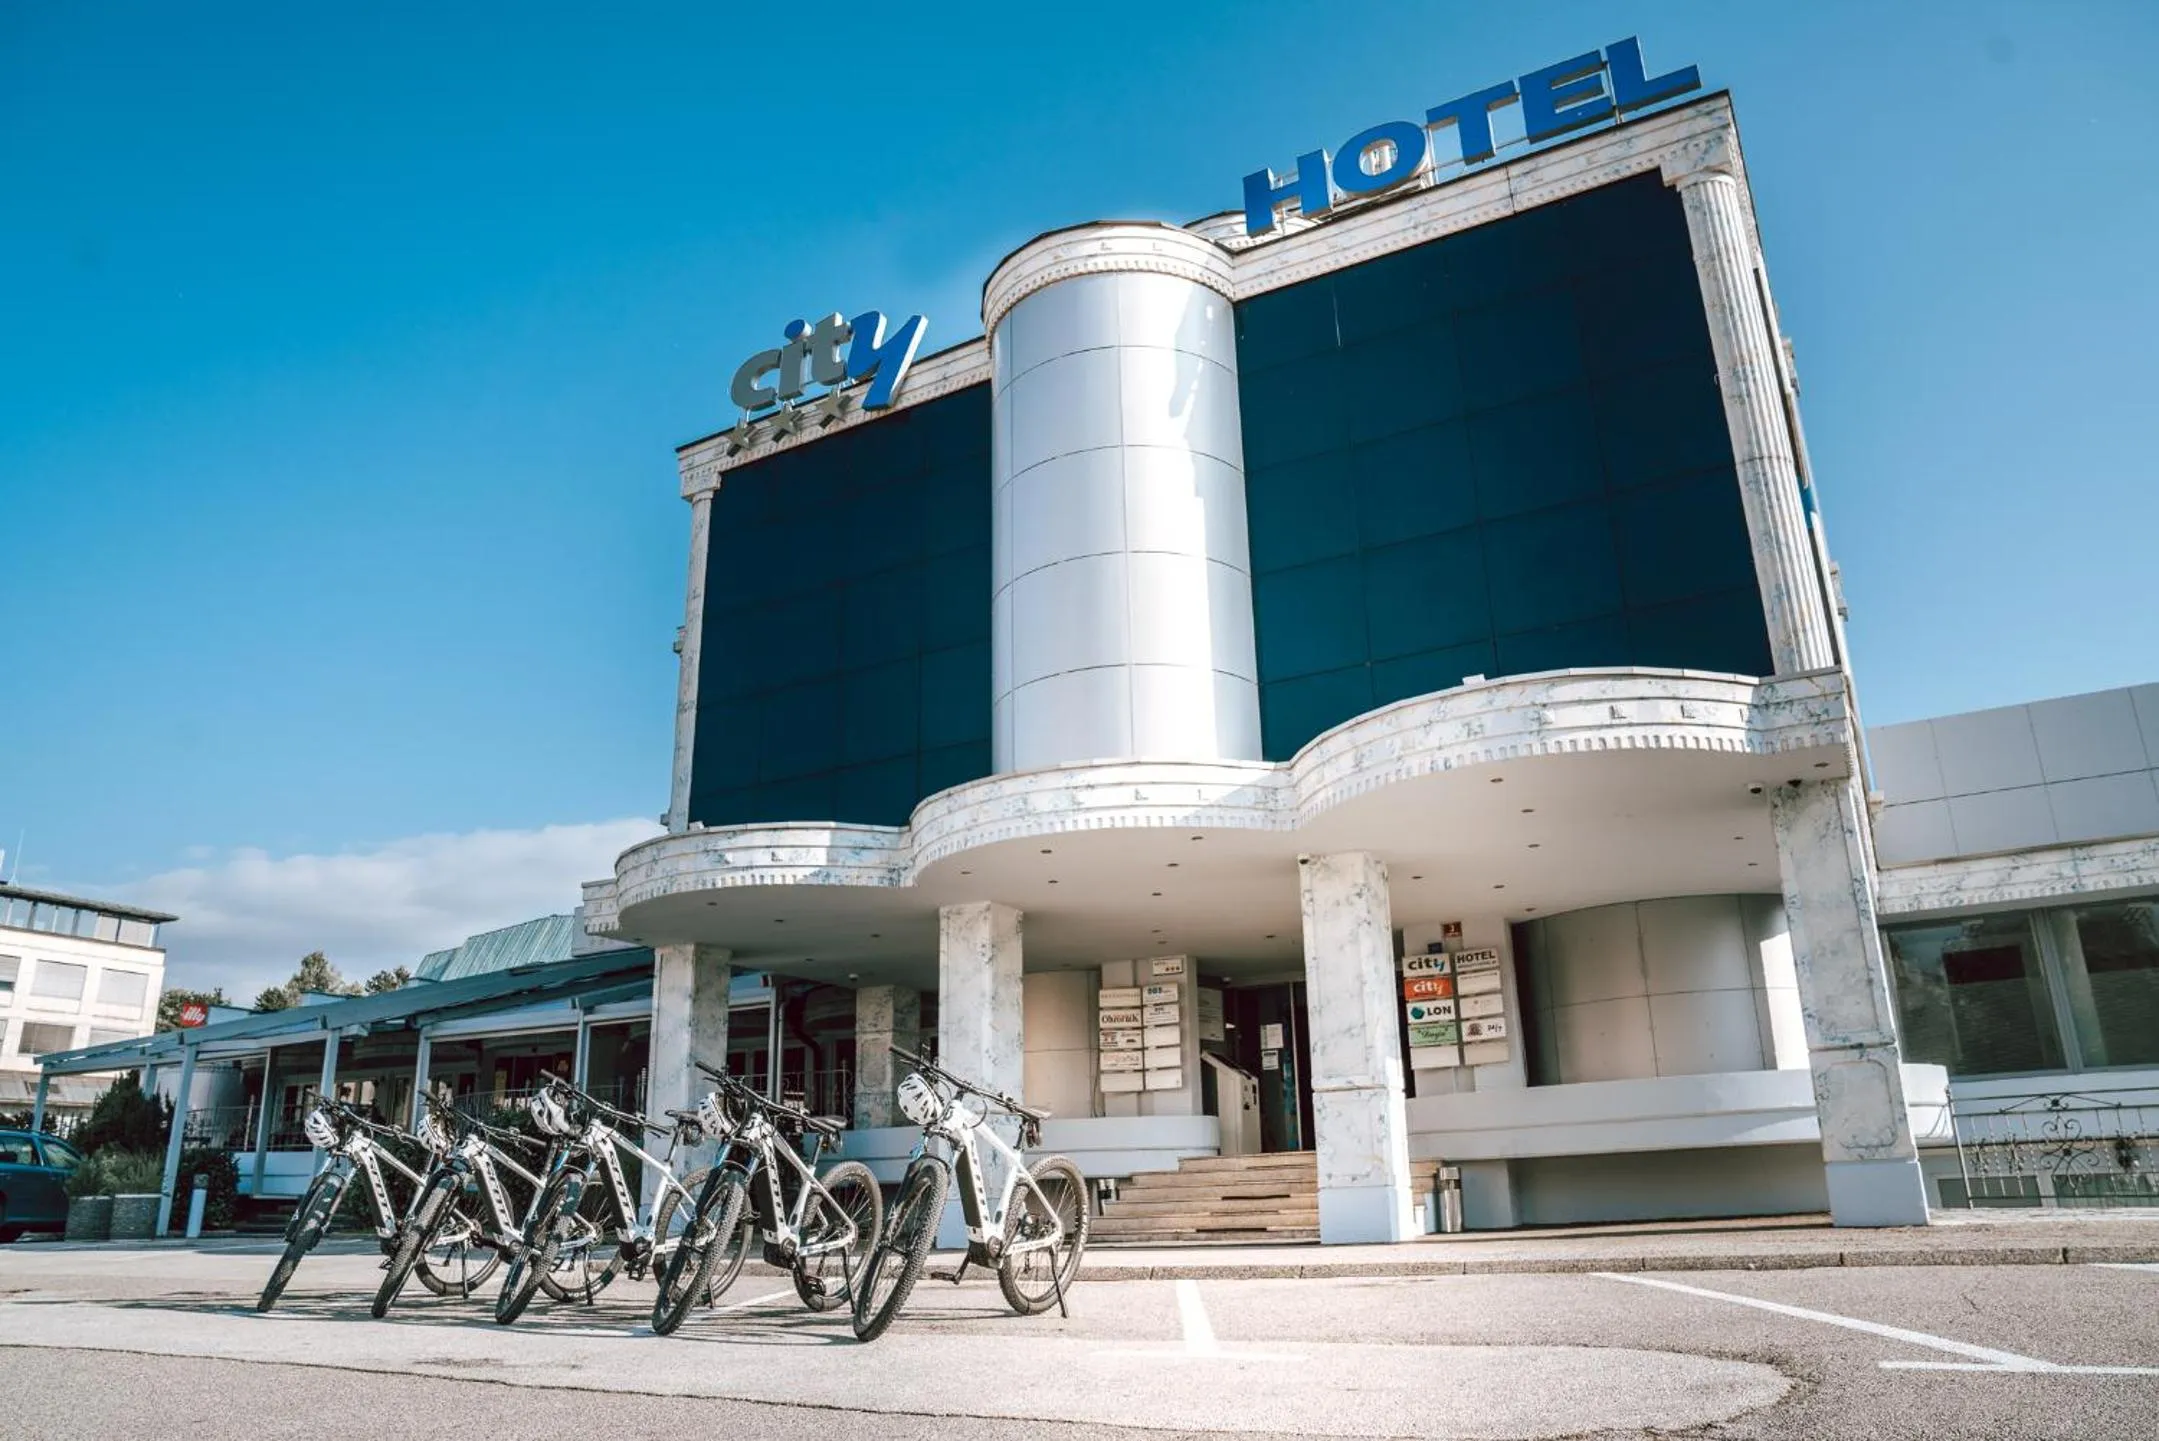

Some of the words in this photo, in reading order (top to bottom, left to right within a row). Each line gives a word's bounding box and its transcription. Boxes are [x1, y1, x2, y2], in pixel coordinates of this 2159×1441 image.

[1243, 35, 1702, 238] HOTEL
[731, 310, 929, 412] city
[1408, 957, 1446, 972] city
[1456, 951, 1496, 964] HOTEL
[1413, 980, 1445, 996] city
[1427, 1006, 1452, 1016] LON
